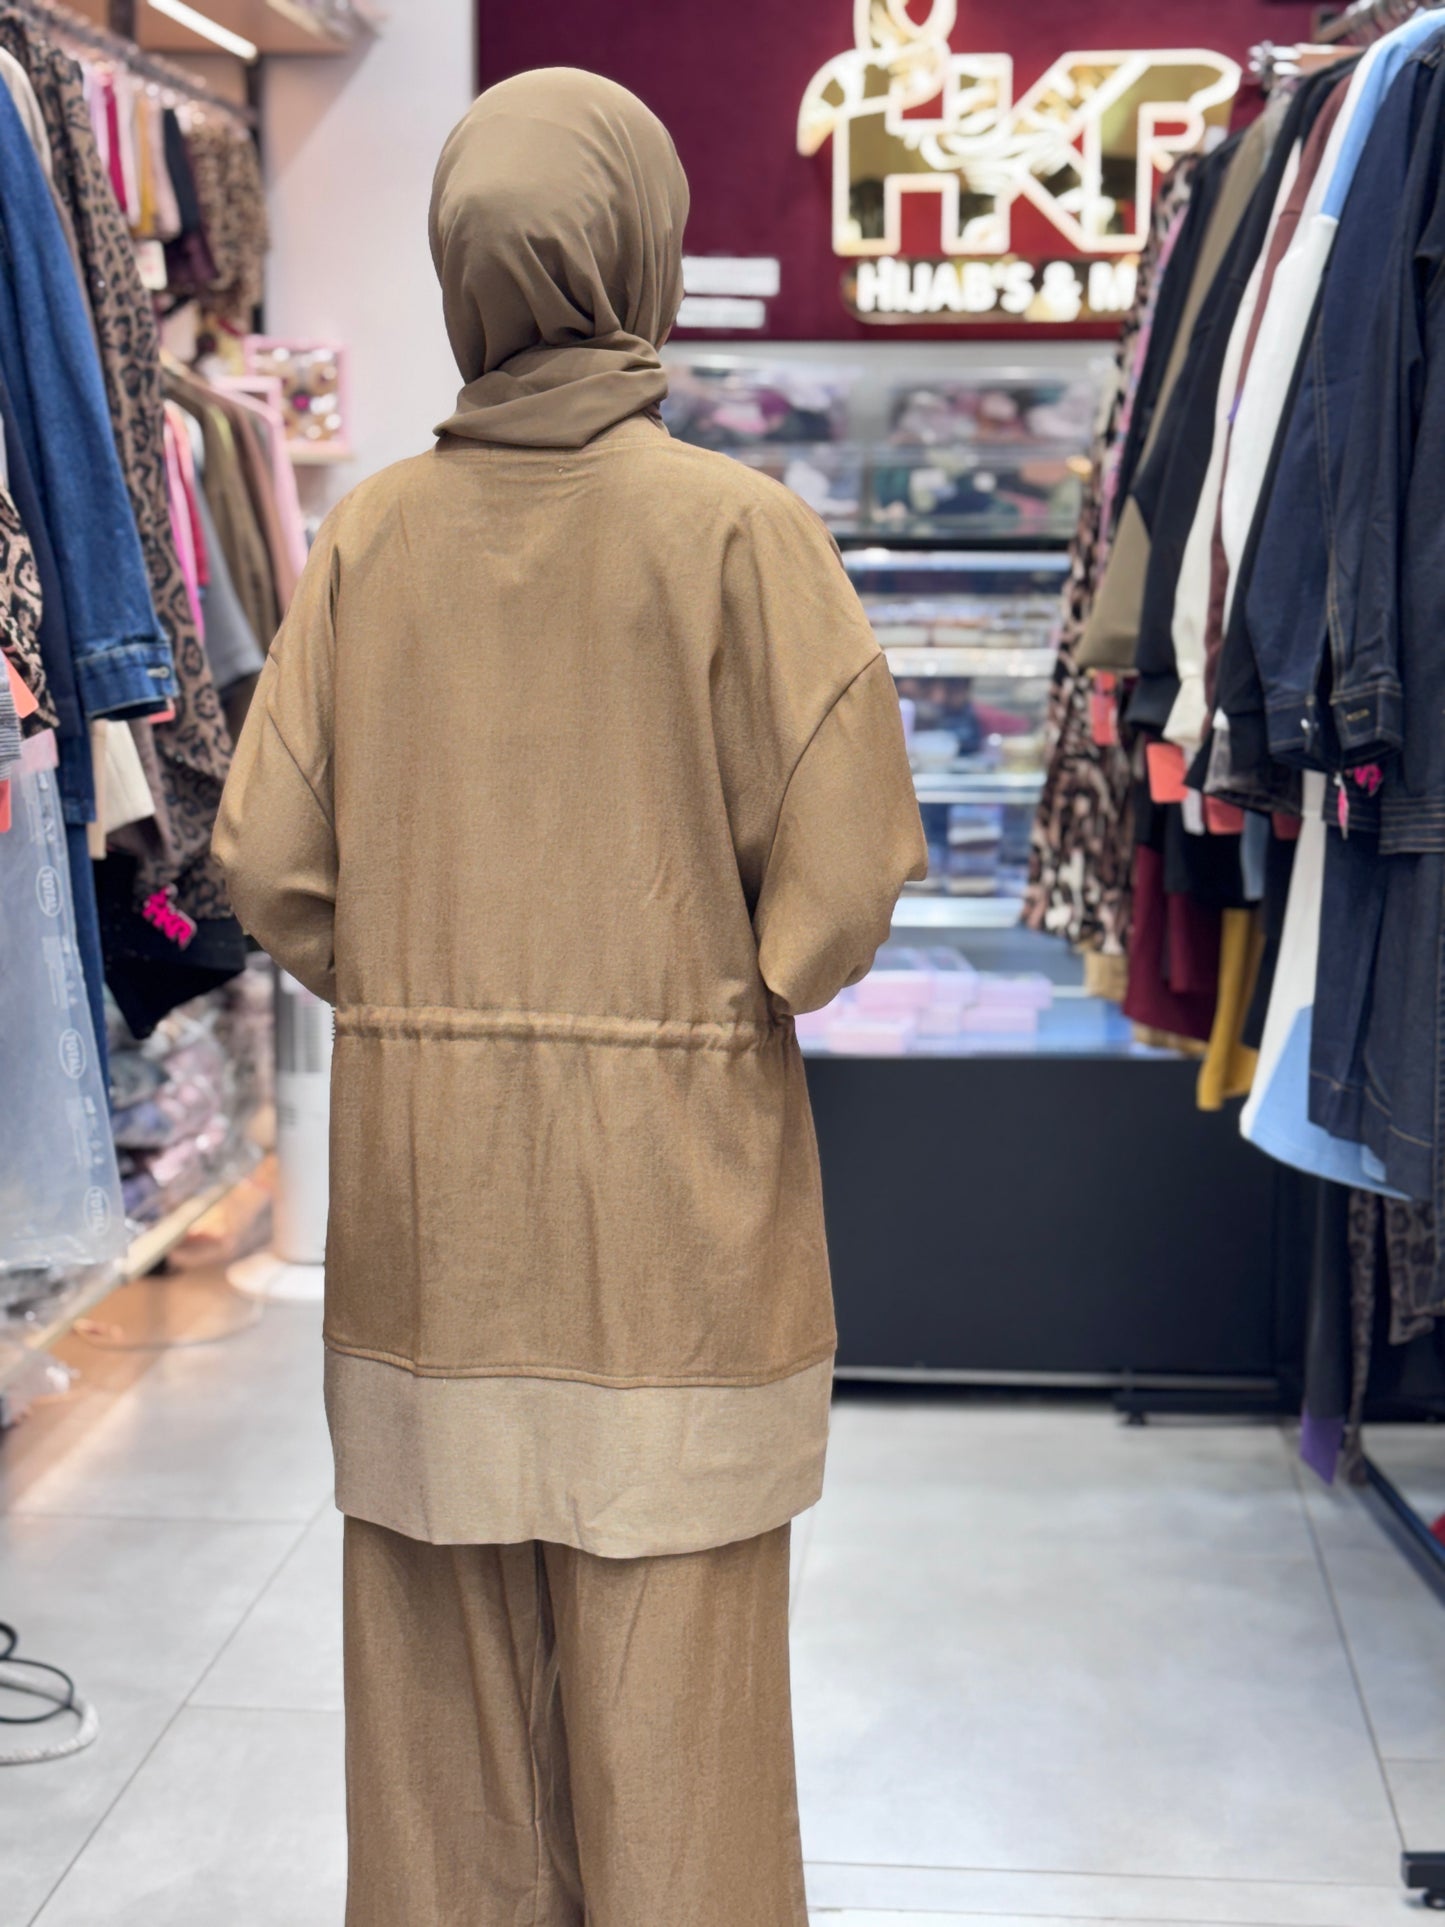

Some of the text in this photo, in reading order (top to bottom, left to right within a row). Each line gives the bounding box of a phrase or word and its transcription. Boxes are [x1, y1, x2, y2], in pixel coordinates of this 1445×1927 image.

[1087, 259, 1140, 313] M
[40, 868, 59, 914] TOTAL
[63, 1031, 83, 1074] TOTAL
